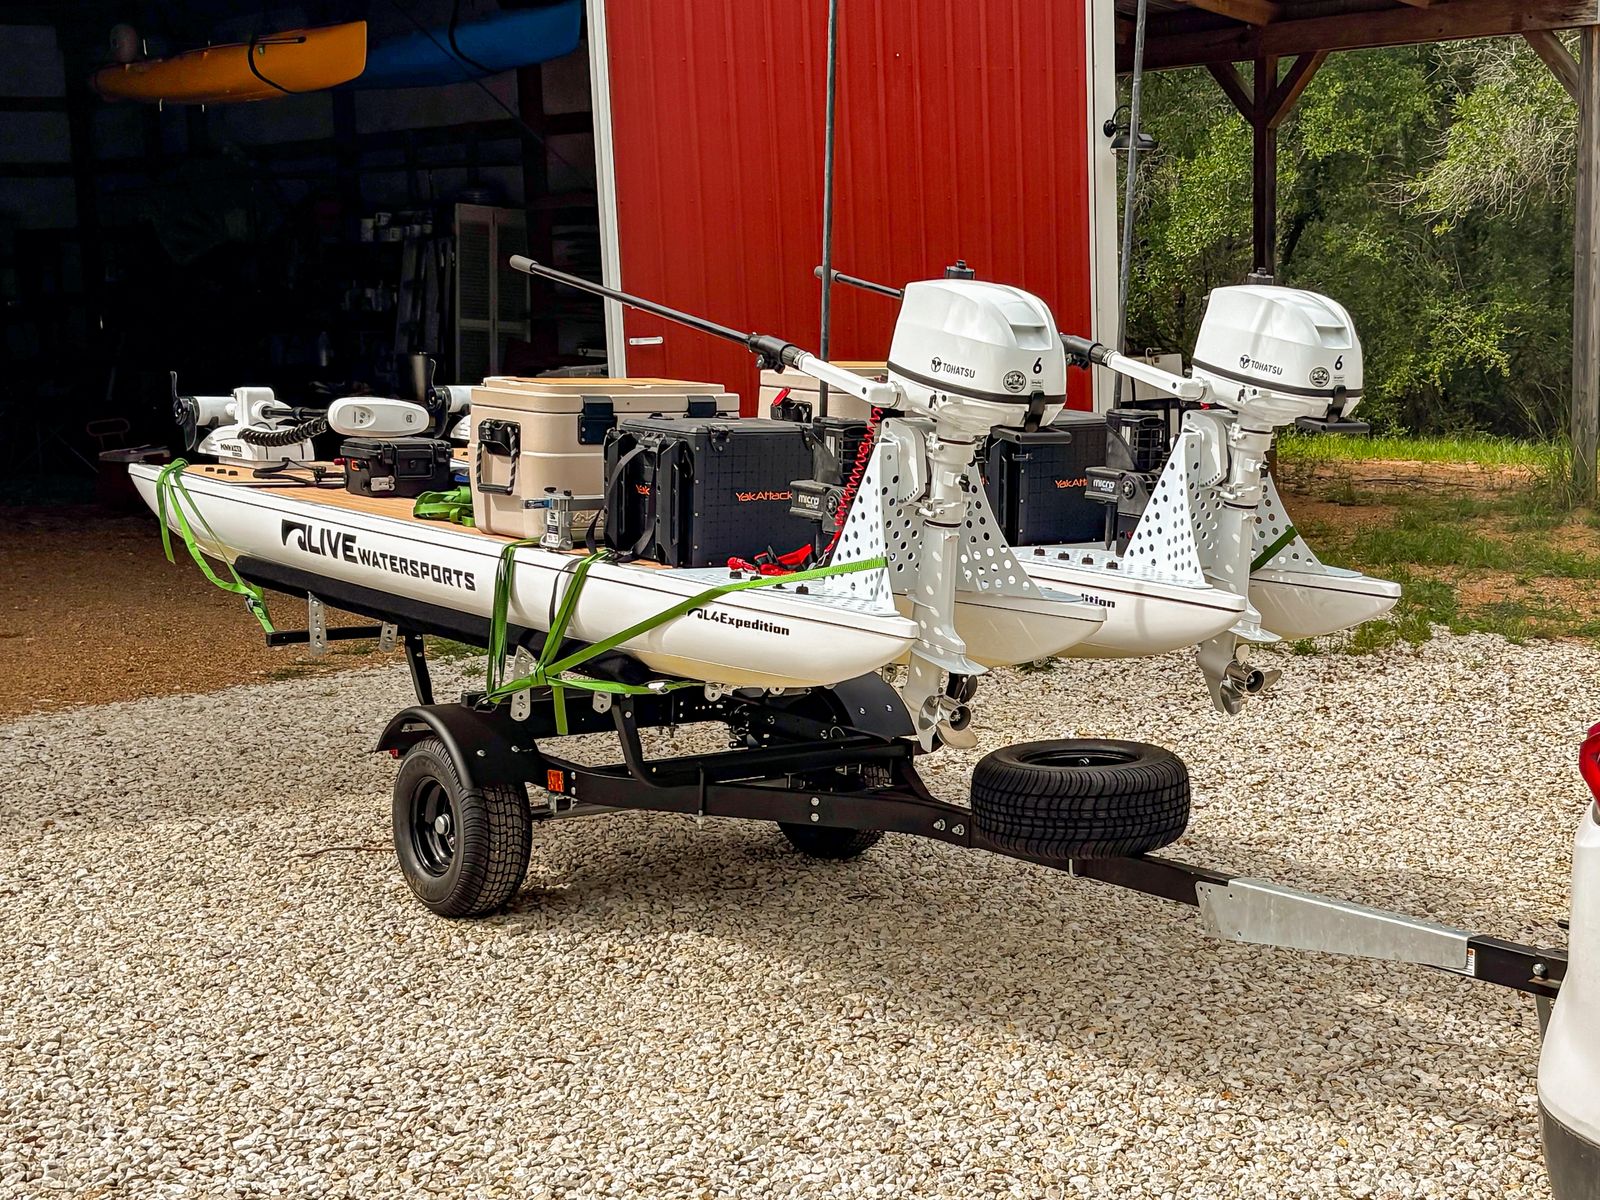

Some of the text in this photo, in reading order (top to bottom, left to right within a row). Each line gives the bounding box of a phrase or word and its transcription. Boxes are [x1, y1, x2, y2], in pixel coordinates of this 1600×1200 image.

[942, 362, 976, 379] TOHATSU
[1032, 357, 1042, 374] 6
[1251, 360, 1283, 375] TOHATSU
[1334, 355, 1343, 371] 6
[1092, 479, 1116, 489] micro
[735, 490, 793, 502] YakAttack
[798, 494, 820, 505] micro
[307, 525, 476, 592] LIVE WATERSPORTS
